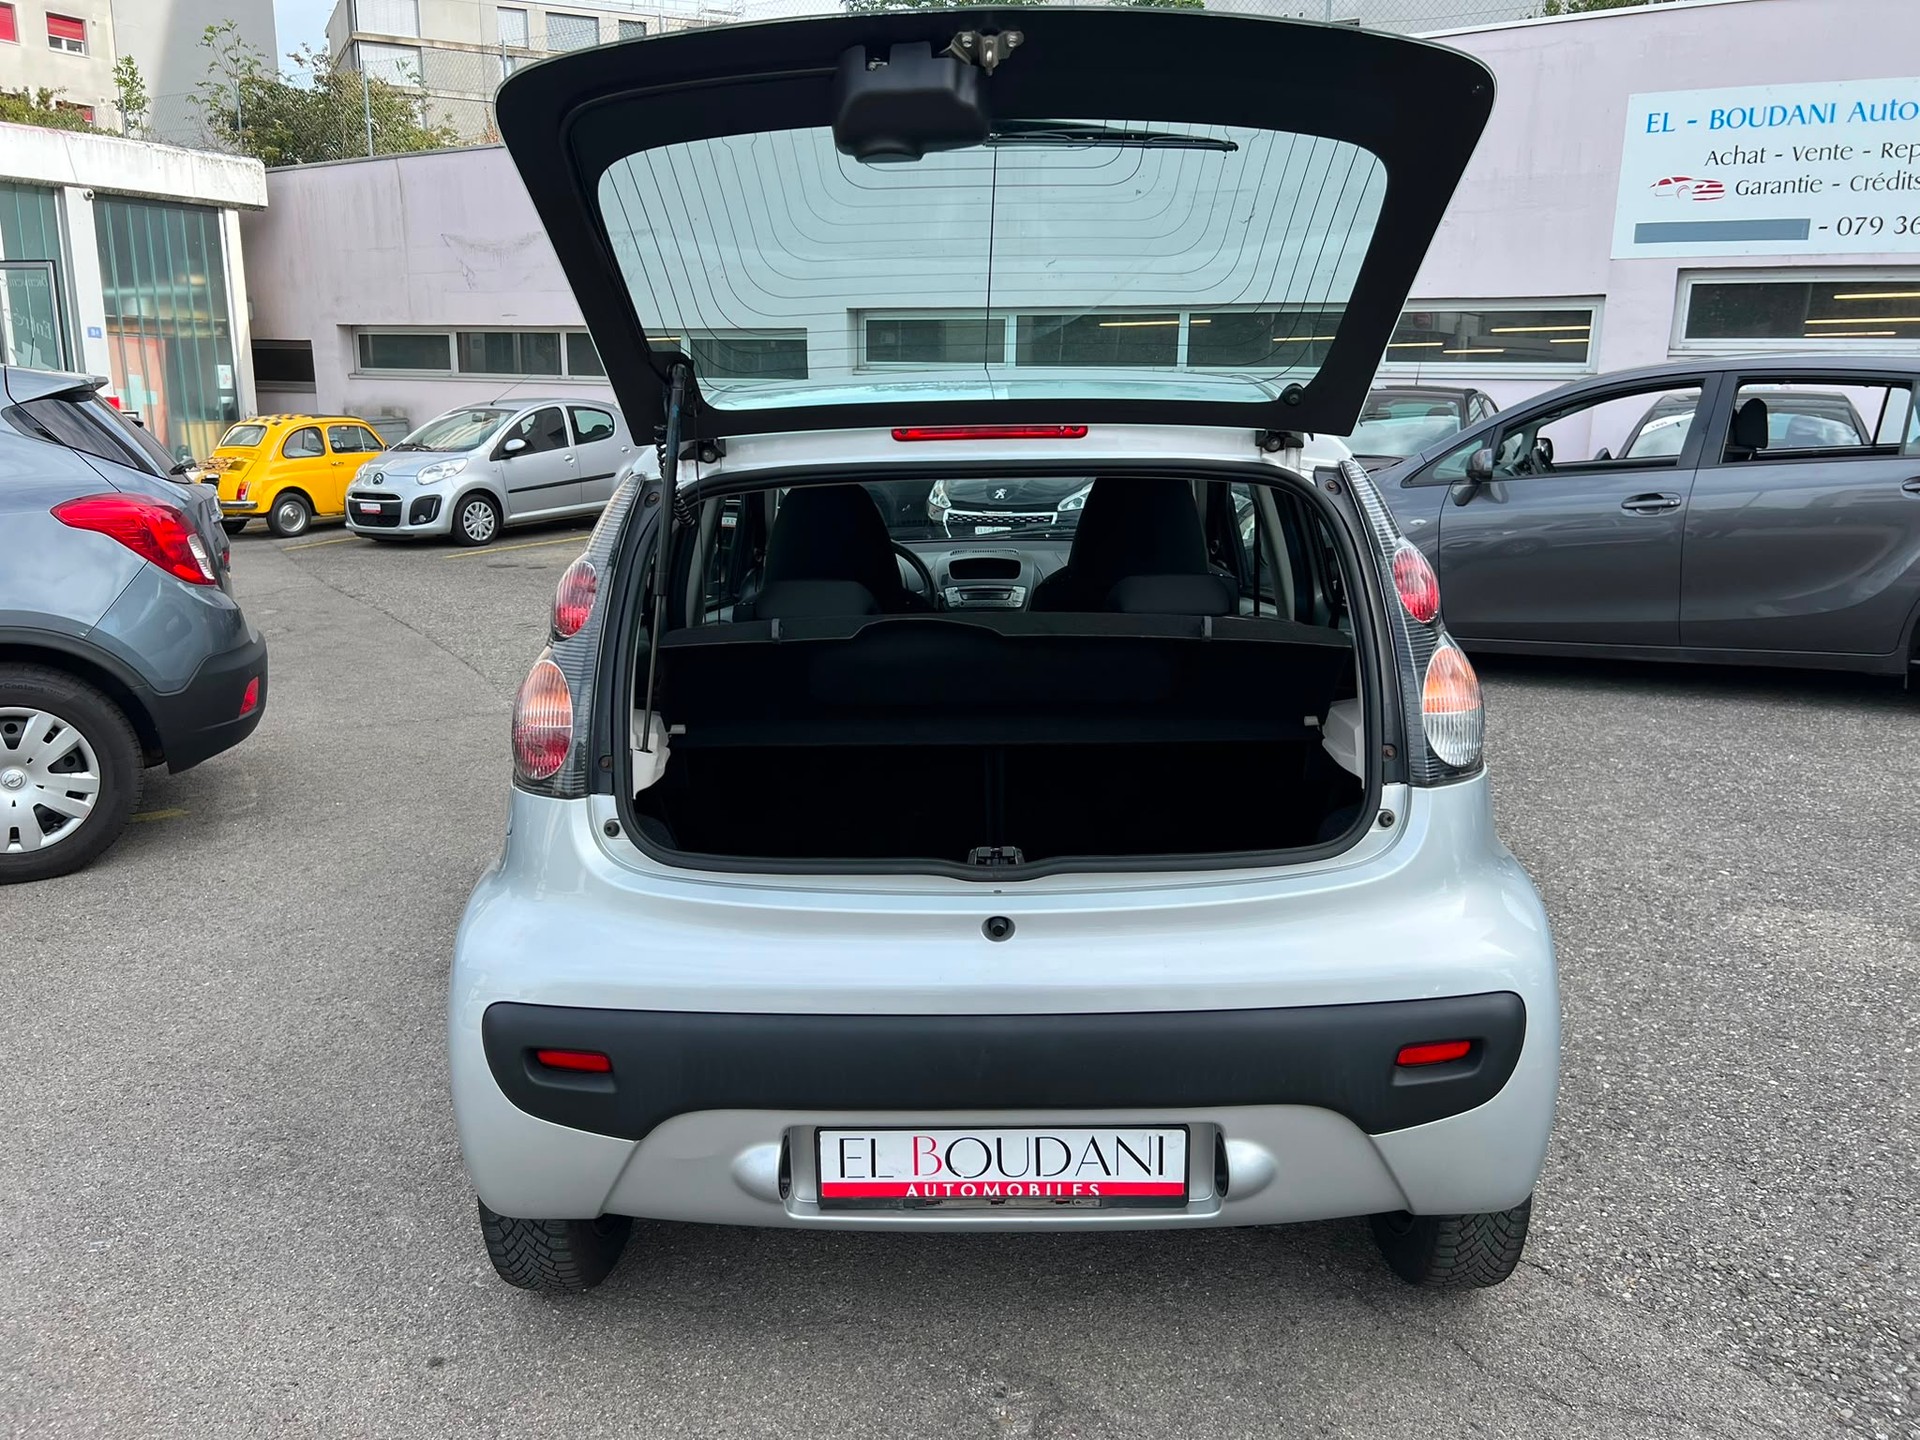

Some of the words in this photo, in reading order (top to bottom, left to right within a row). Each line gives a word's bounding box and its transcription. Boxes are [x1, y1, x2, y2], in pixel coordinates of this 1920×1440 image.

[1646, 112, 1676, 133] EL
[1709, 102, 1837, 130] BOUDANI
[1704, 145, 1767, 167] Achat
[1792, 144, 1854, 162] Vente
[1735, 174, 1823, 196] Garantie
[1836, 215, 1884, 236] 079
[839, 1137, 895, 1178] EL
[912, 1135, 1164, 1179] BOUDANI
[905, 1183, 1100, 1197] AUTOMOBILES
